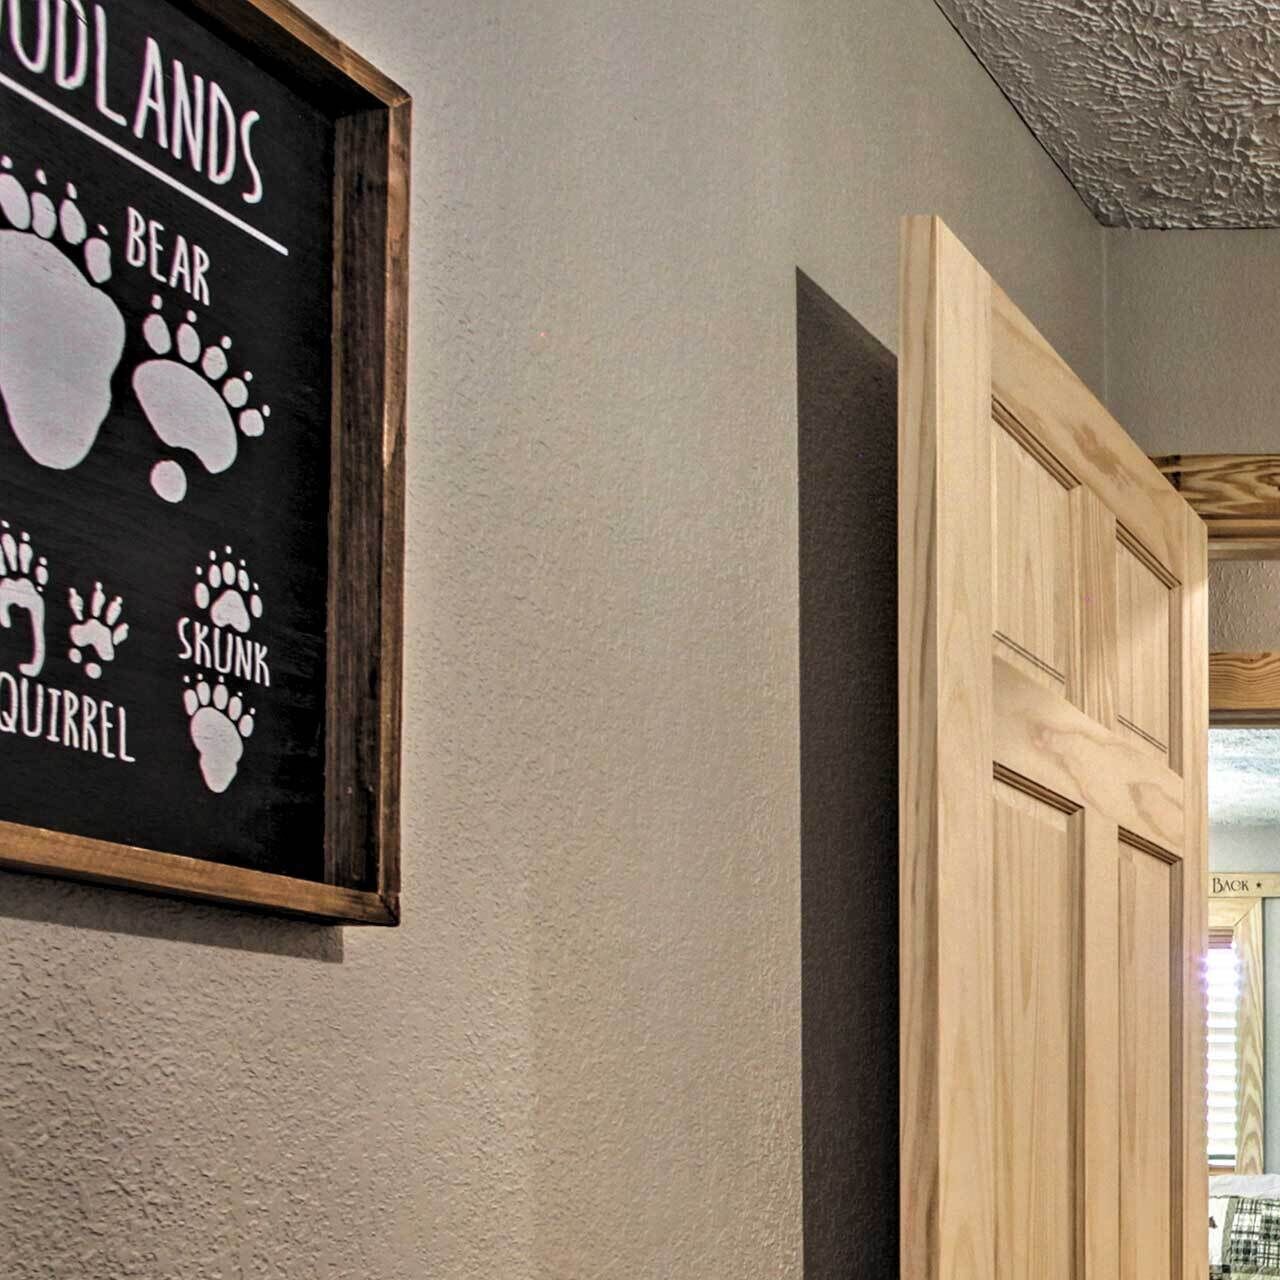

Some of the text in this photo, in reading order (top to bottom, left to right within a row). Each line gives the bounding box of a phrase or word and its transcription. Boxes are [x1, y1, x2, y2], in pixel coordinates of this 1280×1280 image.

[0, 0, 263, 204] ODLANDS
[125, 205, 211, 307] BEAR
[177, 615, 271, 688] SKUNK
